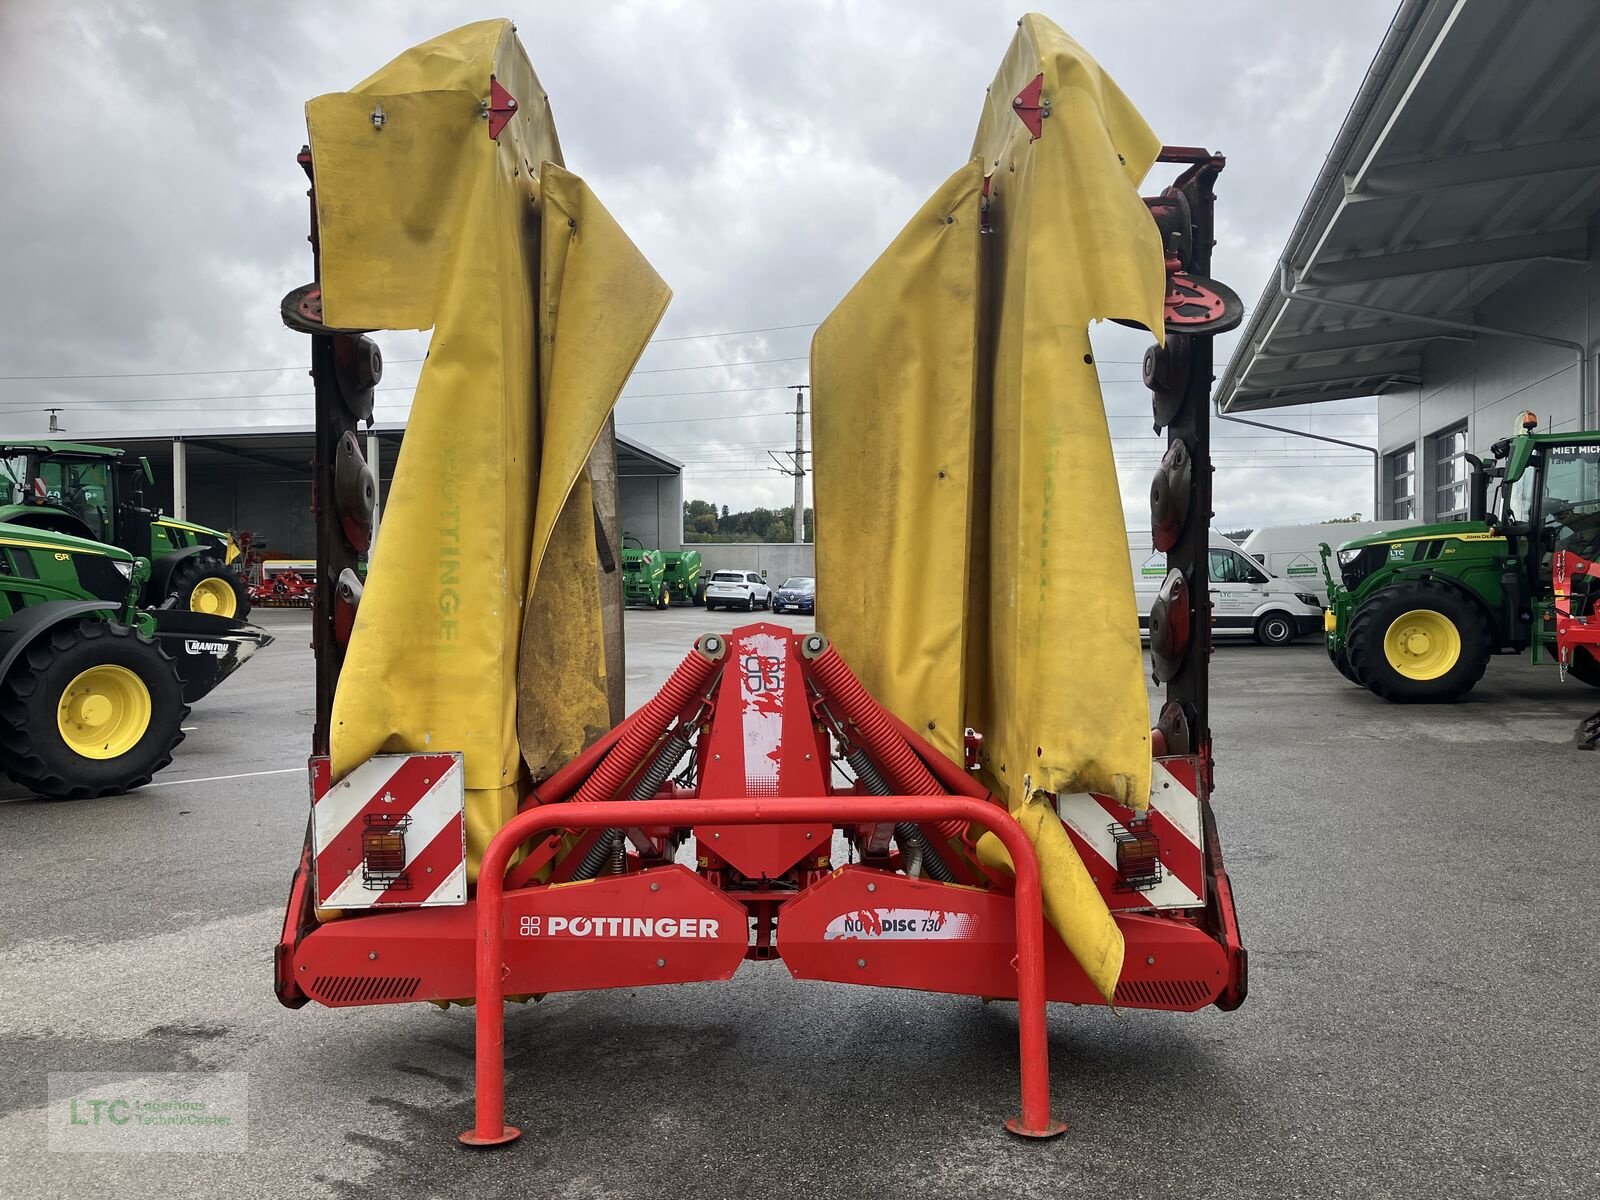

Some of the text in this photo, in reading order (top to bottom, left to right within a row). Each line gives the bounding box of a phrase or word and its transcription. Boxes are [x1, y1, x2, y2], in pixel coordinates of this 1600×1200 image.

[1552, 446, 1577, 454] MIET
[54, 553, 70, 561] 6R
[1390, 549, 1405, 557] LTC
[191, 642, 229, 651] MANITOU
[547, 916, 720, 939] PÖTTINGER
[921, 919, 941, 932] 730
